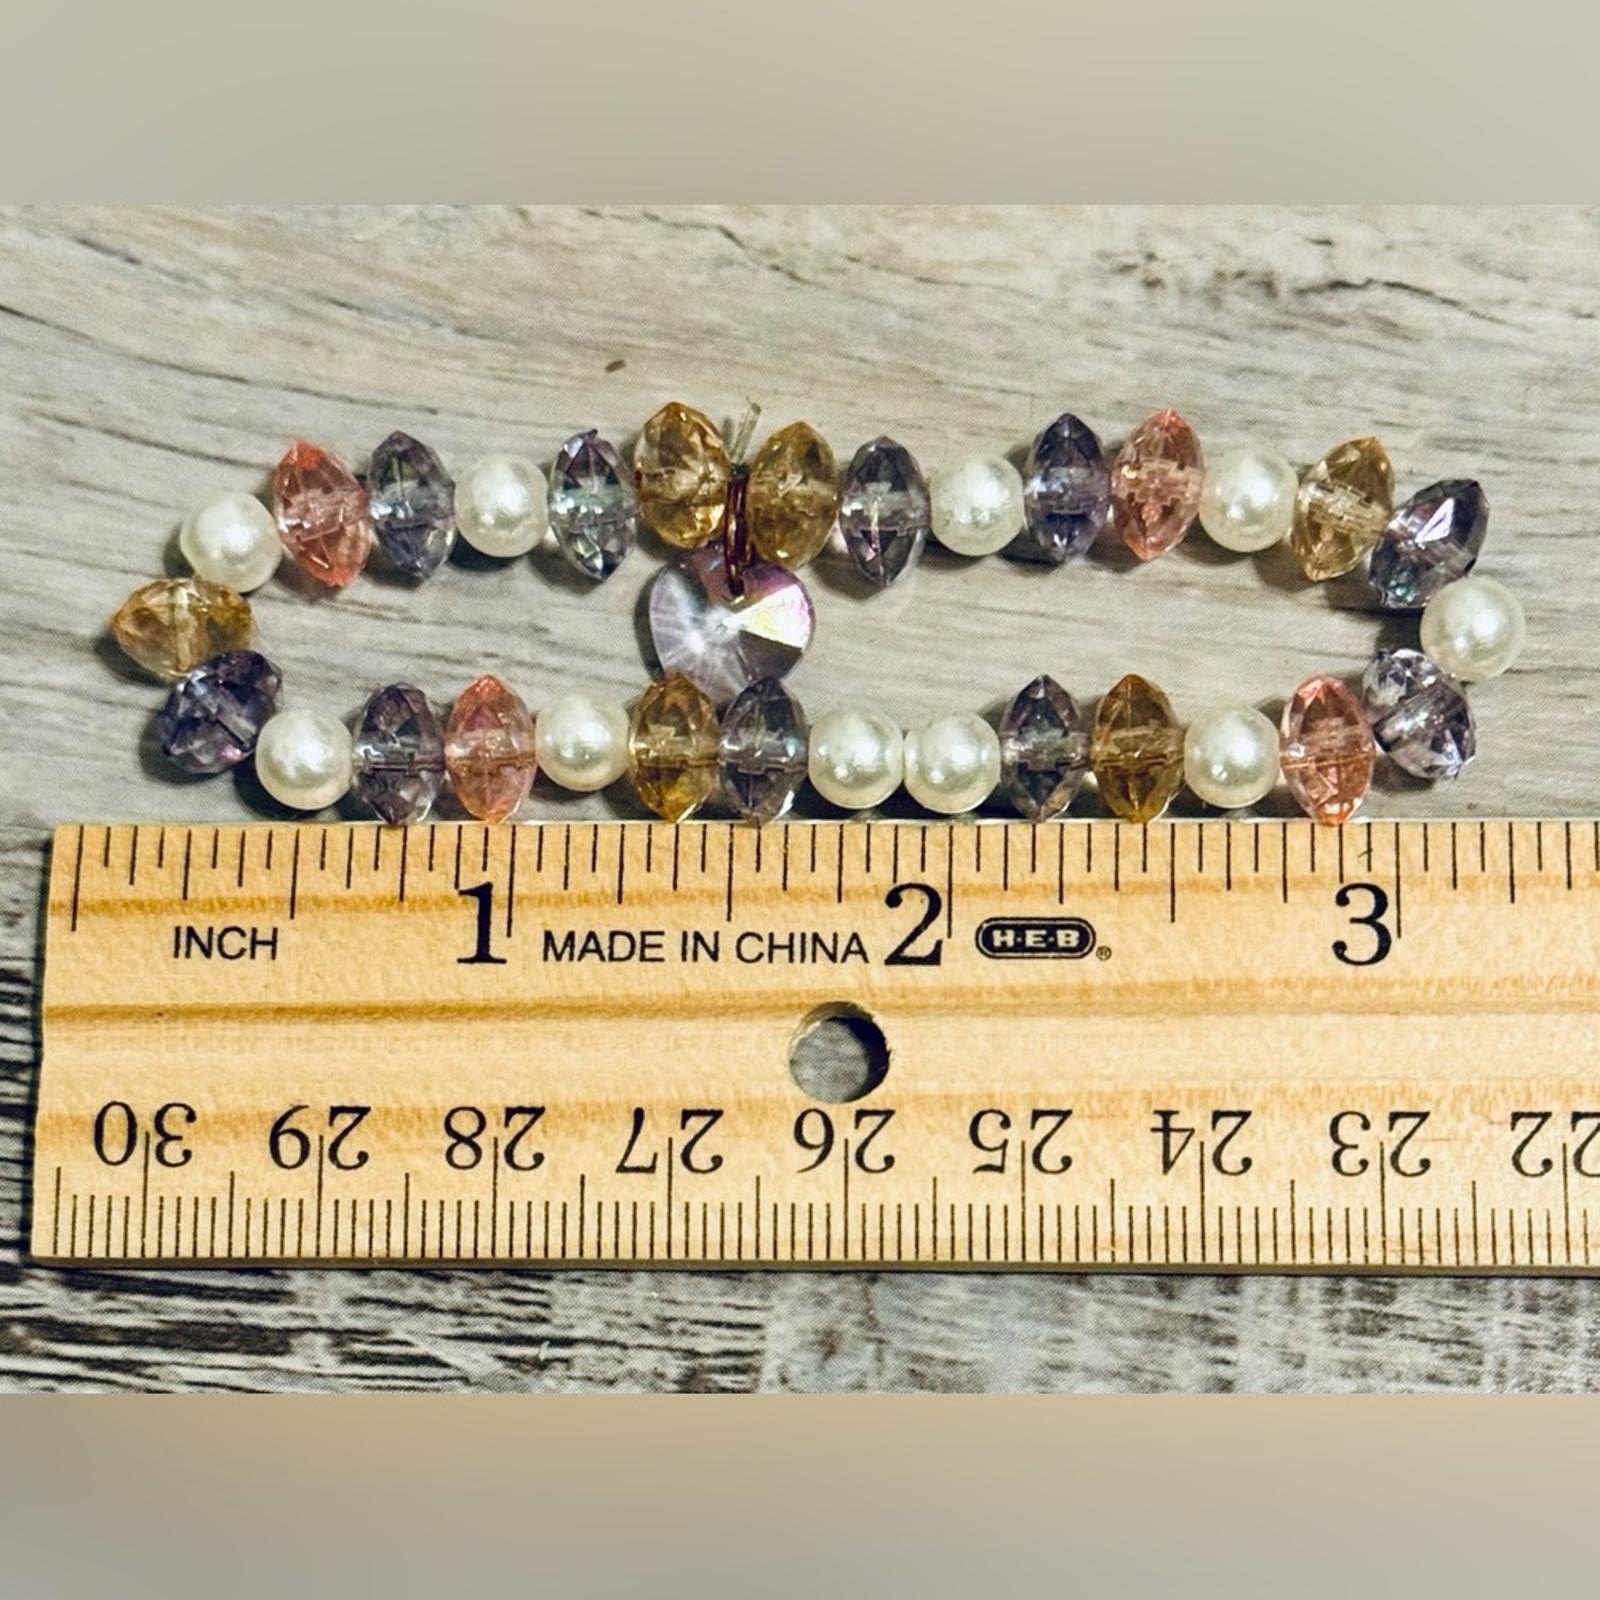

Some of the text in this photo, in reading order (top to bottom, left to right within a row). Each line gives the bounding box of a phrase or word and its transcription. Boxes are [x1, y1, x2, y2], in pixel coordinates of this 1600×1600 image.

[173, 926, 278, 960] INCH
[457, 881, 507, 965] 1
[543, 930, 869, 964] MADE IN CHINA
[884, 882, 943, 966] 2
[1332, 882, 1392, 966] 3
[93, 1101, 197, 1167] 30
[269, 1105, 371, 1170] 29
[443, 1106, 546, 1170] 28
[615, 1107, 724, 1174] 27
[793, 1108, 895, 1174] 26
[969, 1109, 1073, 1174] 25
[1150, 1110, 1252, 1176] 24
[1329, 1111, 1431, 1177] 23
